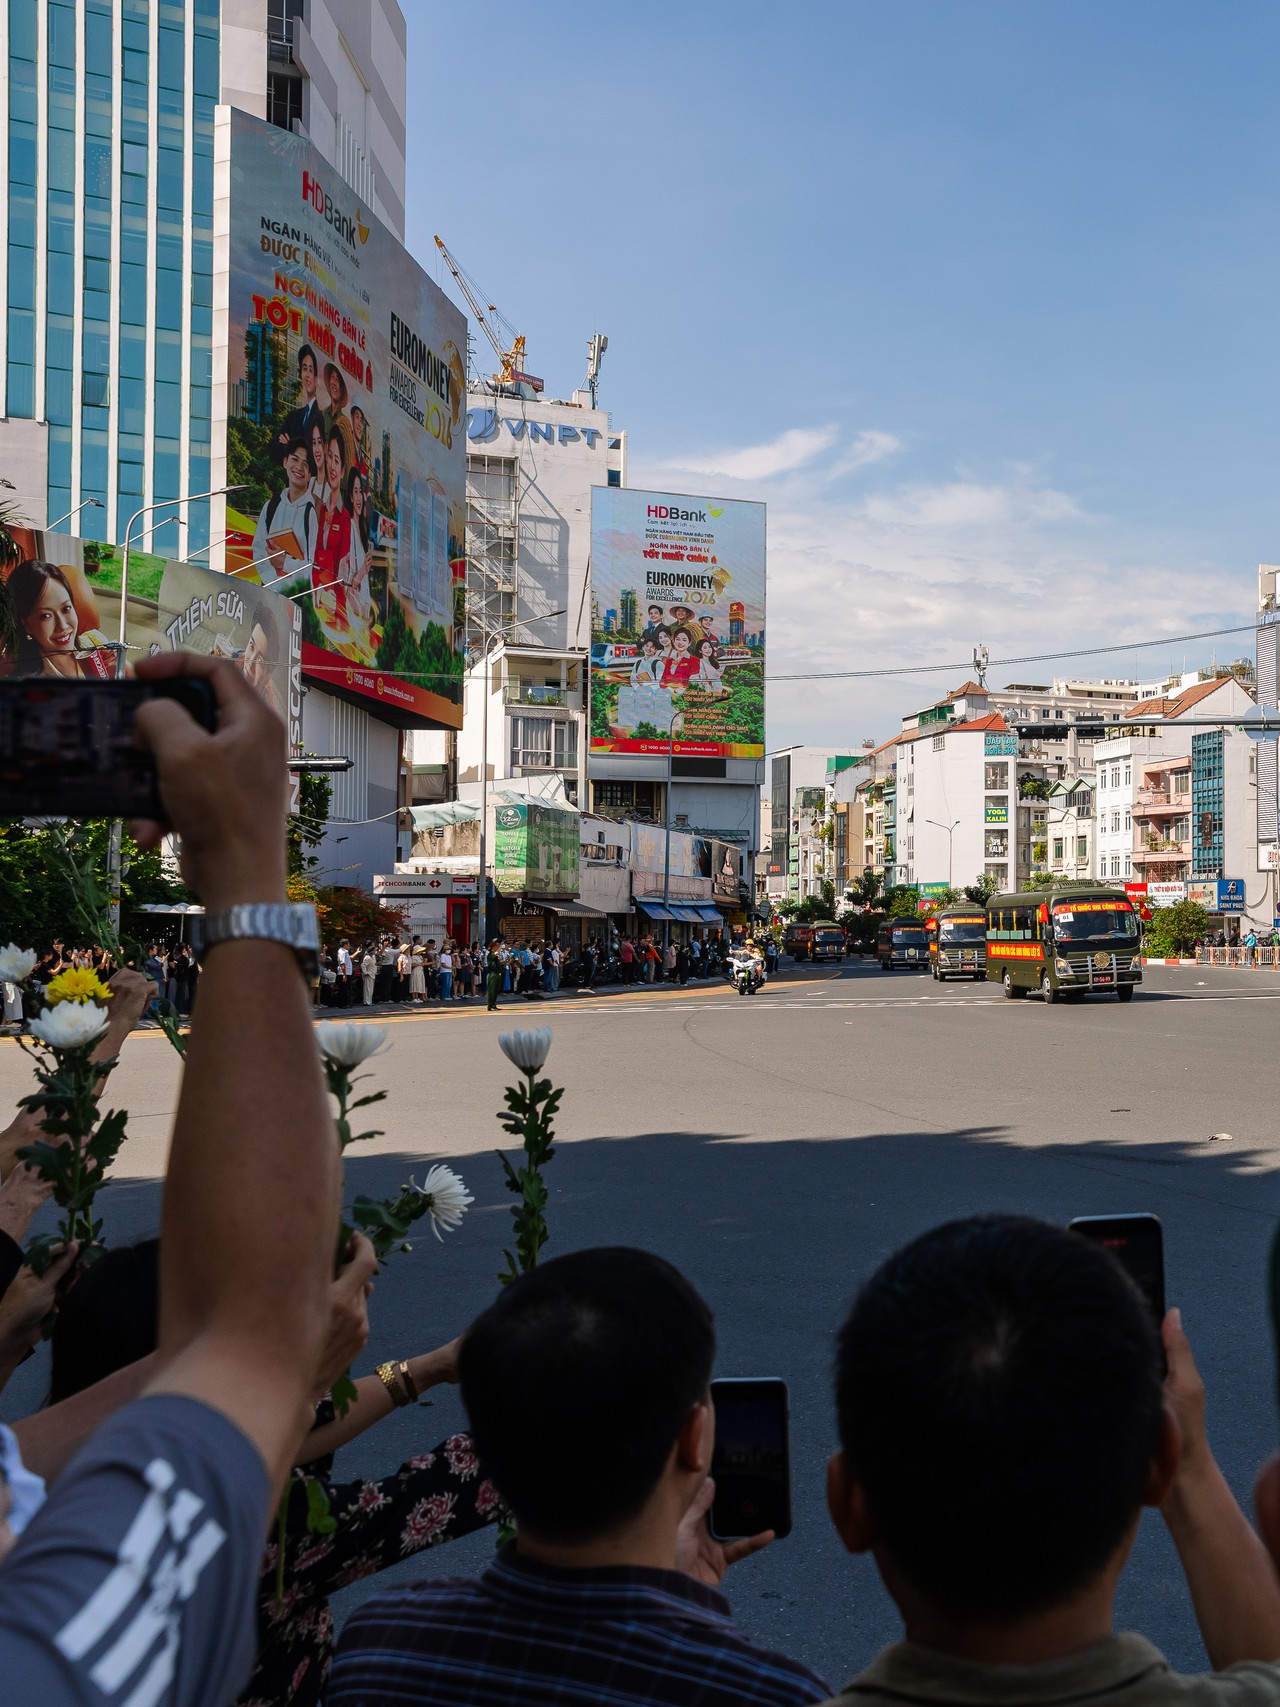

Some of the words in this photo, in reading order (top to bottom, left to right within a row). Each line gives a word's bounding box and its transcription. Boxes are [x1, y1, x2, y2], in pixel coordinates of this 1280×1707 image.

[302, 170, 356, 250] HDBank
[260, 216, 300, 242] NGÂN
[260, 234, 300, 265] ĐƯỢC
[274, 271, 316, 308] NGÂN
[318, 294, 340, 328] HÀNG
[342, 315, 357, 344] BÁN
[251, 292, 304, 336] TỐT
[307, 314, 336, 362] NHẤT
[337, 341, 364, 384] CHÂU
[391, 310, 451, 404] EUROMONEY
[390, 362, 417, 404] AWARDS
[399, 393, 426, 428] EXCELLENCE
[504, 418, 600, 446] VNPT
[648, 505, 706, 522] HDBank
[643, 548, 660, 559] TỐT
[650, 542, 668, 550] NGÂN
[670, 542, 688, 551] HÀNG
[646, 571, 714, 590] EUROMONEY
[646, 588, 674, 597] AWARDS
[684, 590, 716, 604] 2026
[166, 596, 213, 652] THÊM
[216, 590, 244, 626] SỮA
[1003, 746, 1017, 756] SPA
[513, 904, 522, 914] YZ
